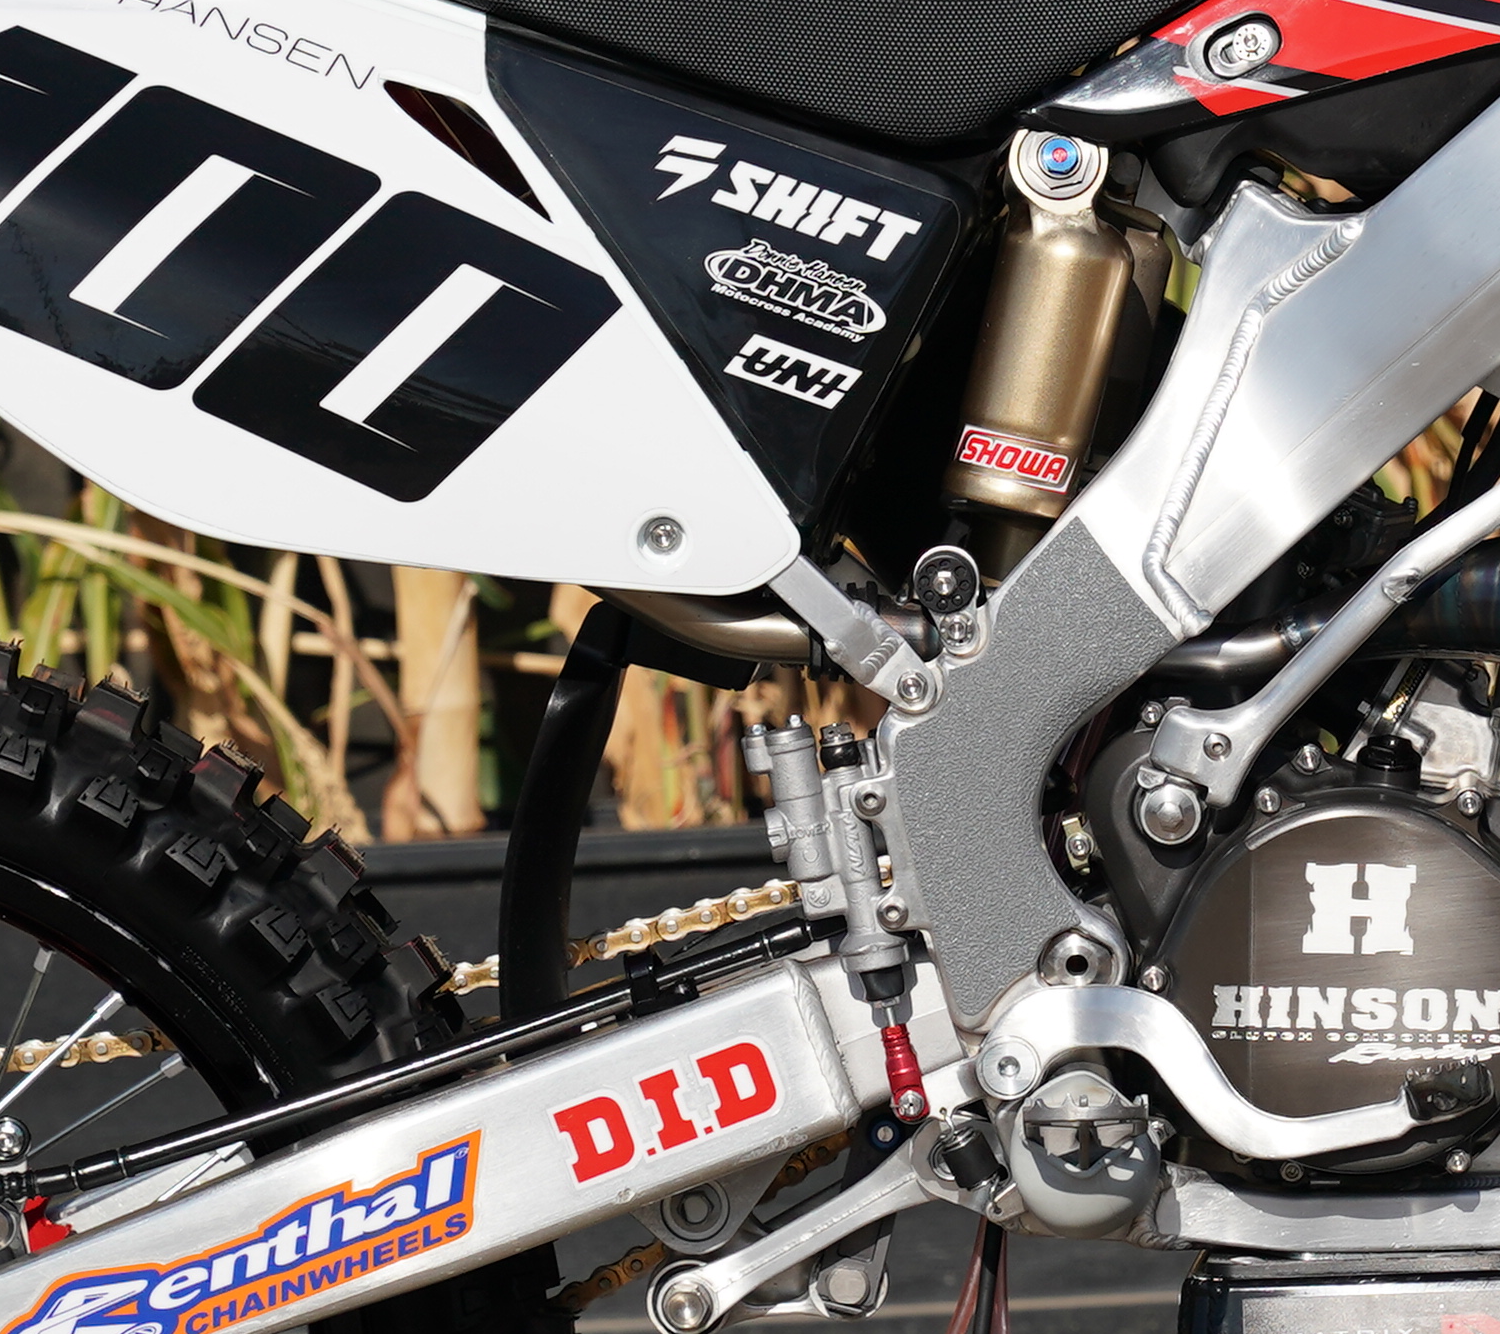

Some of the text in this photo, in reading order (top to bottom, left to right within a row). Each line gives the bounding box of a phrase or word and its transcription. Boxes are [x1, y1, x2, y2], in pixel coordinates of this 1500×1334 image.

[711, 159, 923, 262] SHIFT
[710, 282, 866, 343] Motocross Academy
[719, 255, 869, 330] DHMA
[961, 435, 1068, 484] SHOWA
[1301, 861, 1416, 956] H
[553, 1042, 779, 1183] D.I.D
